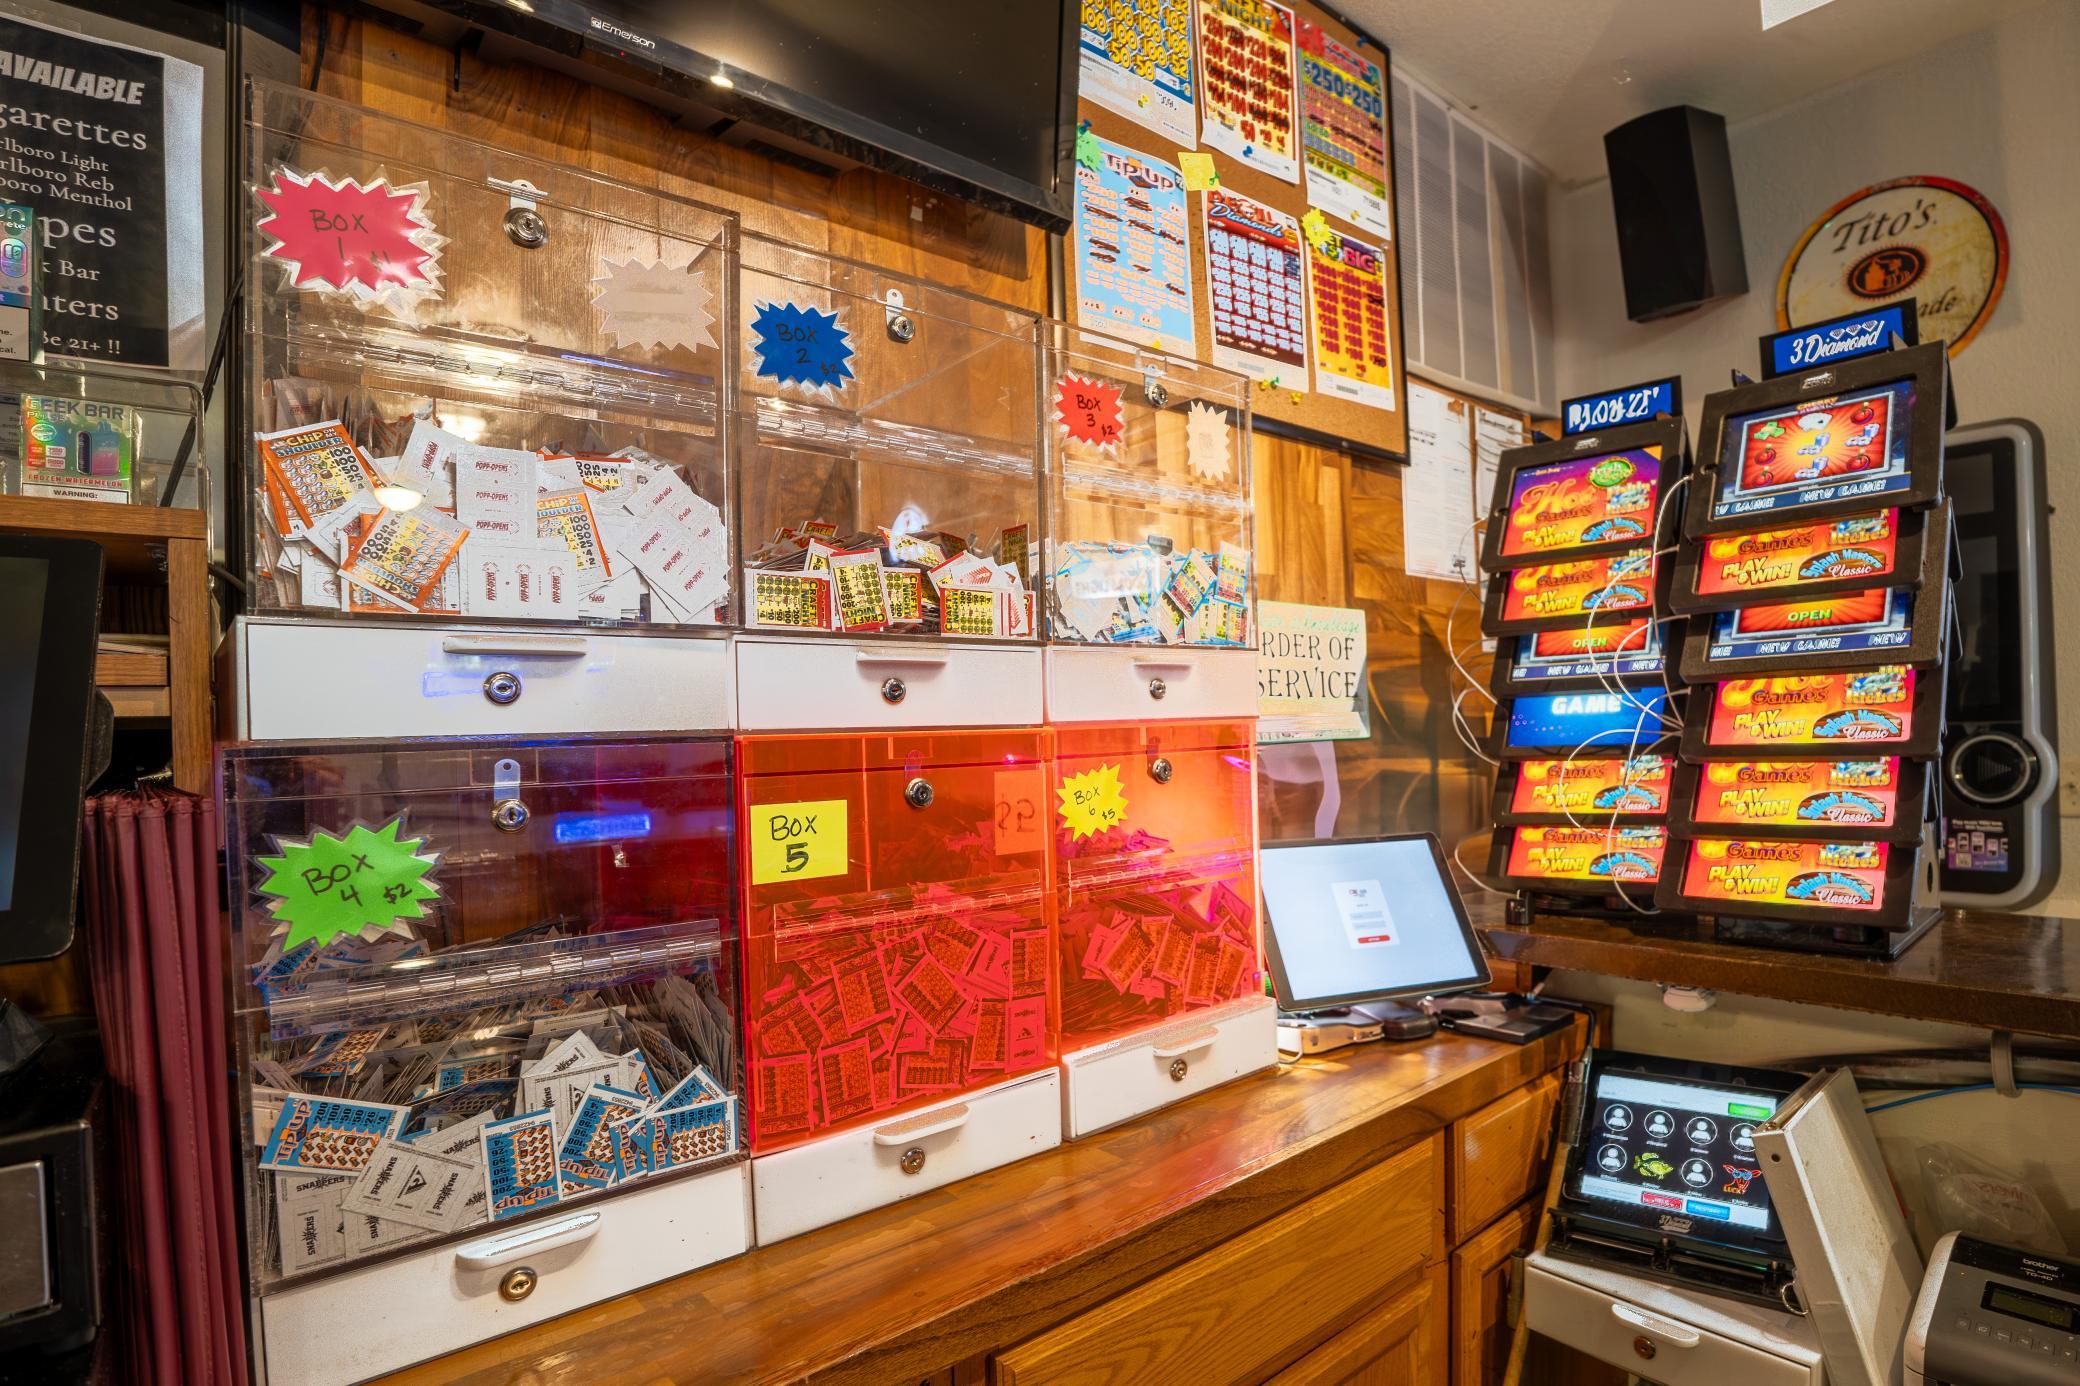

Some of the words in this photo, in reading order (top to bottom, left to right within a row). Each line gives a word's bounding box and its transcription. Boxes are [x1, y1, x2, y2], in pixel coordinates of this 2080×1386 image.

[602, 21, 655, 49] Emerson
[61, 151, 109, 172] Light
[74, 172, 115, 193] Reb
[1102, 152, 1140, 177] Tip
[1143, 166, 1174, 193] Up
[50, 184, 133, 212] Menthol
[309, 209, 368, 234] BOX
[1833, 199, 1938, 254] Tito's
[37, 216, 117, 249] pes
[59, 260, 100, 281] Bar
[1341, 244, 1378, 276] BIG
[776, 323, 818, 345] BOX
[1789, 338, 1803, 364] 3
[1804, 320, 1886, 364] Diamond
[795, 347, 813, 365] 2
[84, 403, 124, 420] BAR
[1076, 394, 1101, 411] BOX
[1086, 414, 1096, 428] 3
[276, 436, 344, 458] SHOULDER
[475, 460, 509, 473] POPP-OPENS
[53, 489, 98, 500] WARNING:
[475, 490, 509, 502] POPP-OPENS
[475, 520, 509, 532] POPP-OPENS
[640, 531, 662, 554] POPP-OPENS
[662, 550, 683, 573] POPP-OPENS
[1721, 556, 1768, 580] PLAY
[1828, 563, 1873, 579] Classic
[684, 569, 705, 592] POPP-OPENS
[1750, 562, 1794, 585] WIN!
[486, 571, 496, 601] POPP-OPENS
[552, 575, 561, 603] POPP-OPENS
[909, 575, 918, 610] CRAFT
[809, 579, 819, 619] CRAFT
[852, 613, 885, 626] CRAFT
[944, 597, 953, 632] CRAFT
[1787, 608, 1833, 622] OPEN
[1262, 631, 1321, 661] RDER
[1328, 636, 1355, 661] OF
[1551, 695, 1623, 715] GAME
[1751, 690, 1829, 705] Games
[1734, 708, 1781, 730] PLAY
[1763, 719, 1807, 740] WIN!
[1842, 723, 1890, 740] Classic
[1736, 766, 1814, 785] Games
[1073, 786, 1101, 806] BOX
[1719, 788, 1766, 808] PLAY
[1088, 803, 1096, 816] 6
[1746, 798, 1792, 819] WIN!
[1826, 806, 1873, 824] Classic
[769, 814, 819, 841] BOX
[781, 841, 810, 873] 5
[1726, 841, 1802, 861] Games
[302, 853, 375, 898] BOX
[1707, 863, 1756, 882] PLAY
[340, 883, 361, 908] 4
[383, 882, 414, 905] $2
[1736, 875, 1781, 895] WIN!
[1814, 887, 1862, 905] Classic
[2022, 1258, 2060, 1271] brother
